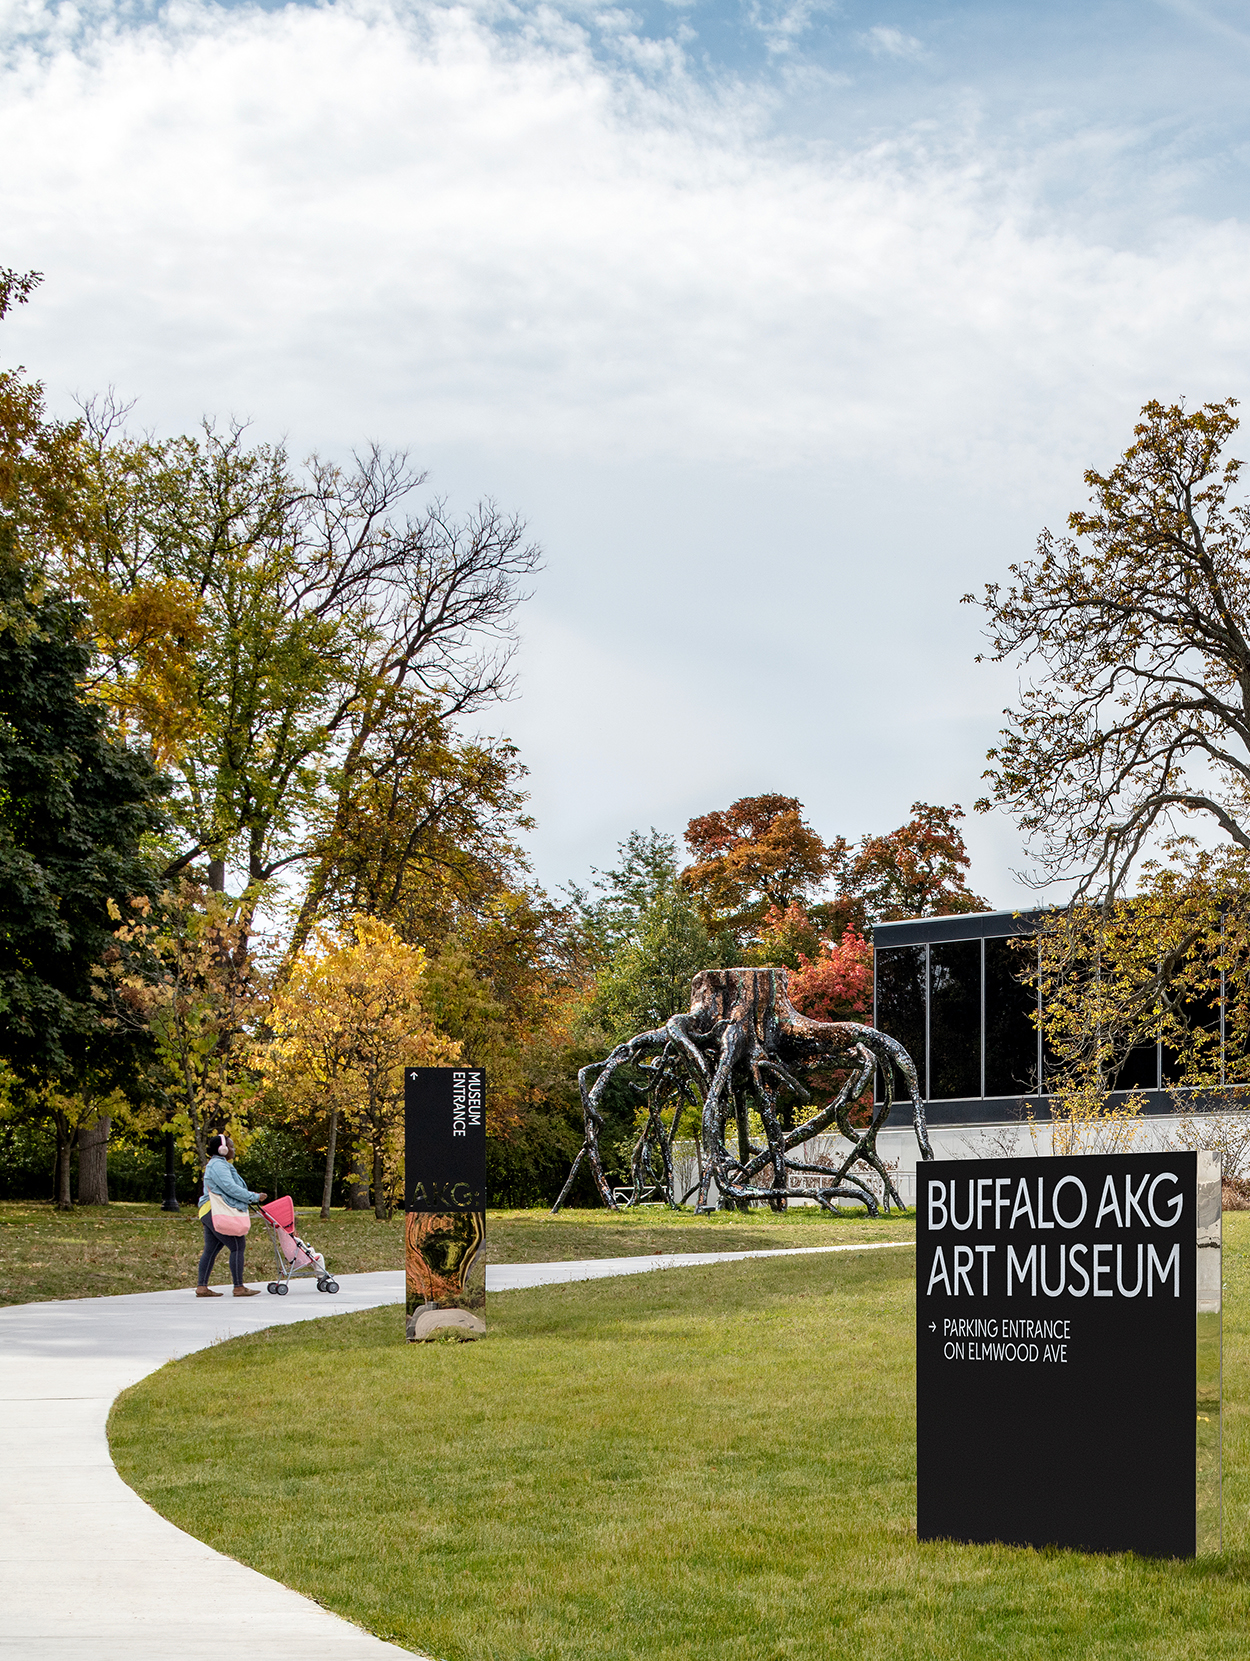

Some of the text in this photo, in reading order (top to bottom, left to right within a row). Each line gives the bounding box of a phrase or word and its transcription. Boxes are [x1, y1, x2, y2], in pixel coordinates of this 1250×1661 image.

[453, 1072, 466, 1137] ENTRANCE
[467, 1072, 481, 1127] MUSEUM
[928, 1172, 1184, 1230] BUFFALO AKG
[926, 1243, 1180, 1298] ART MUSEUM
[943, 1319, 1071, 1339] PARKING ENTRANCE
[944, 1342, 1068, 1363] ON ELMWOOD AVE
